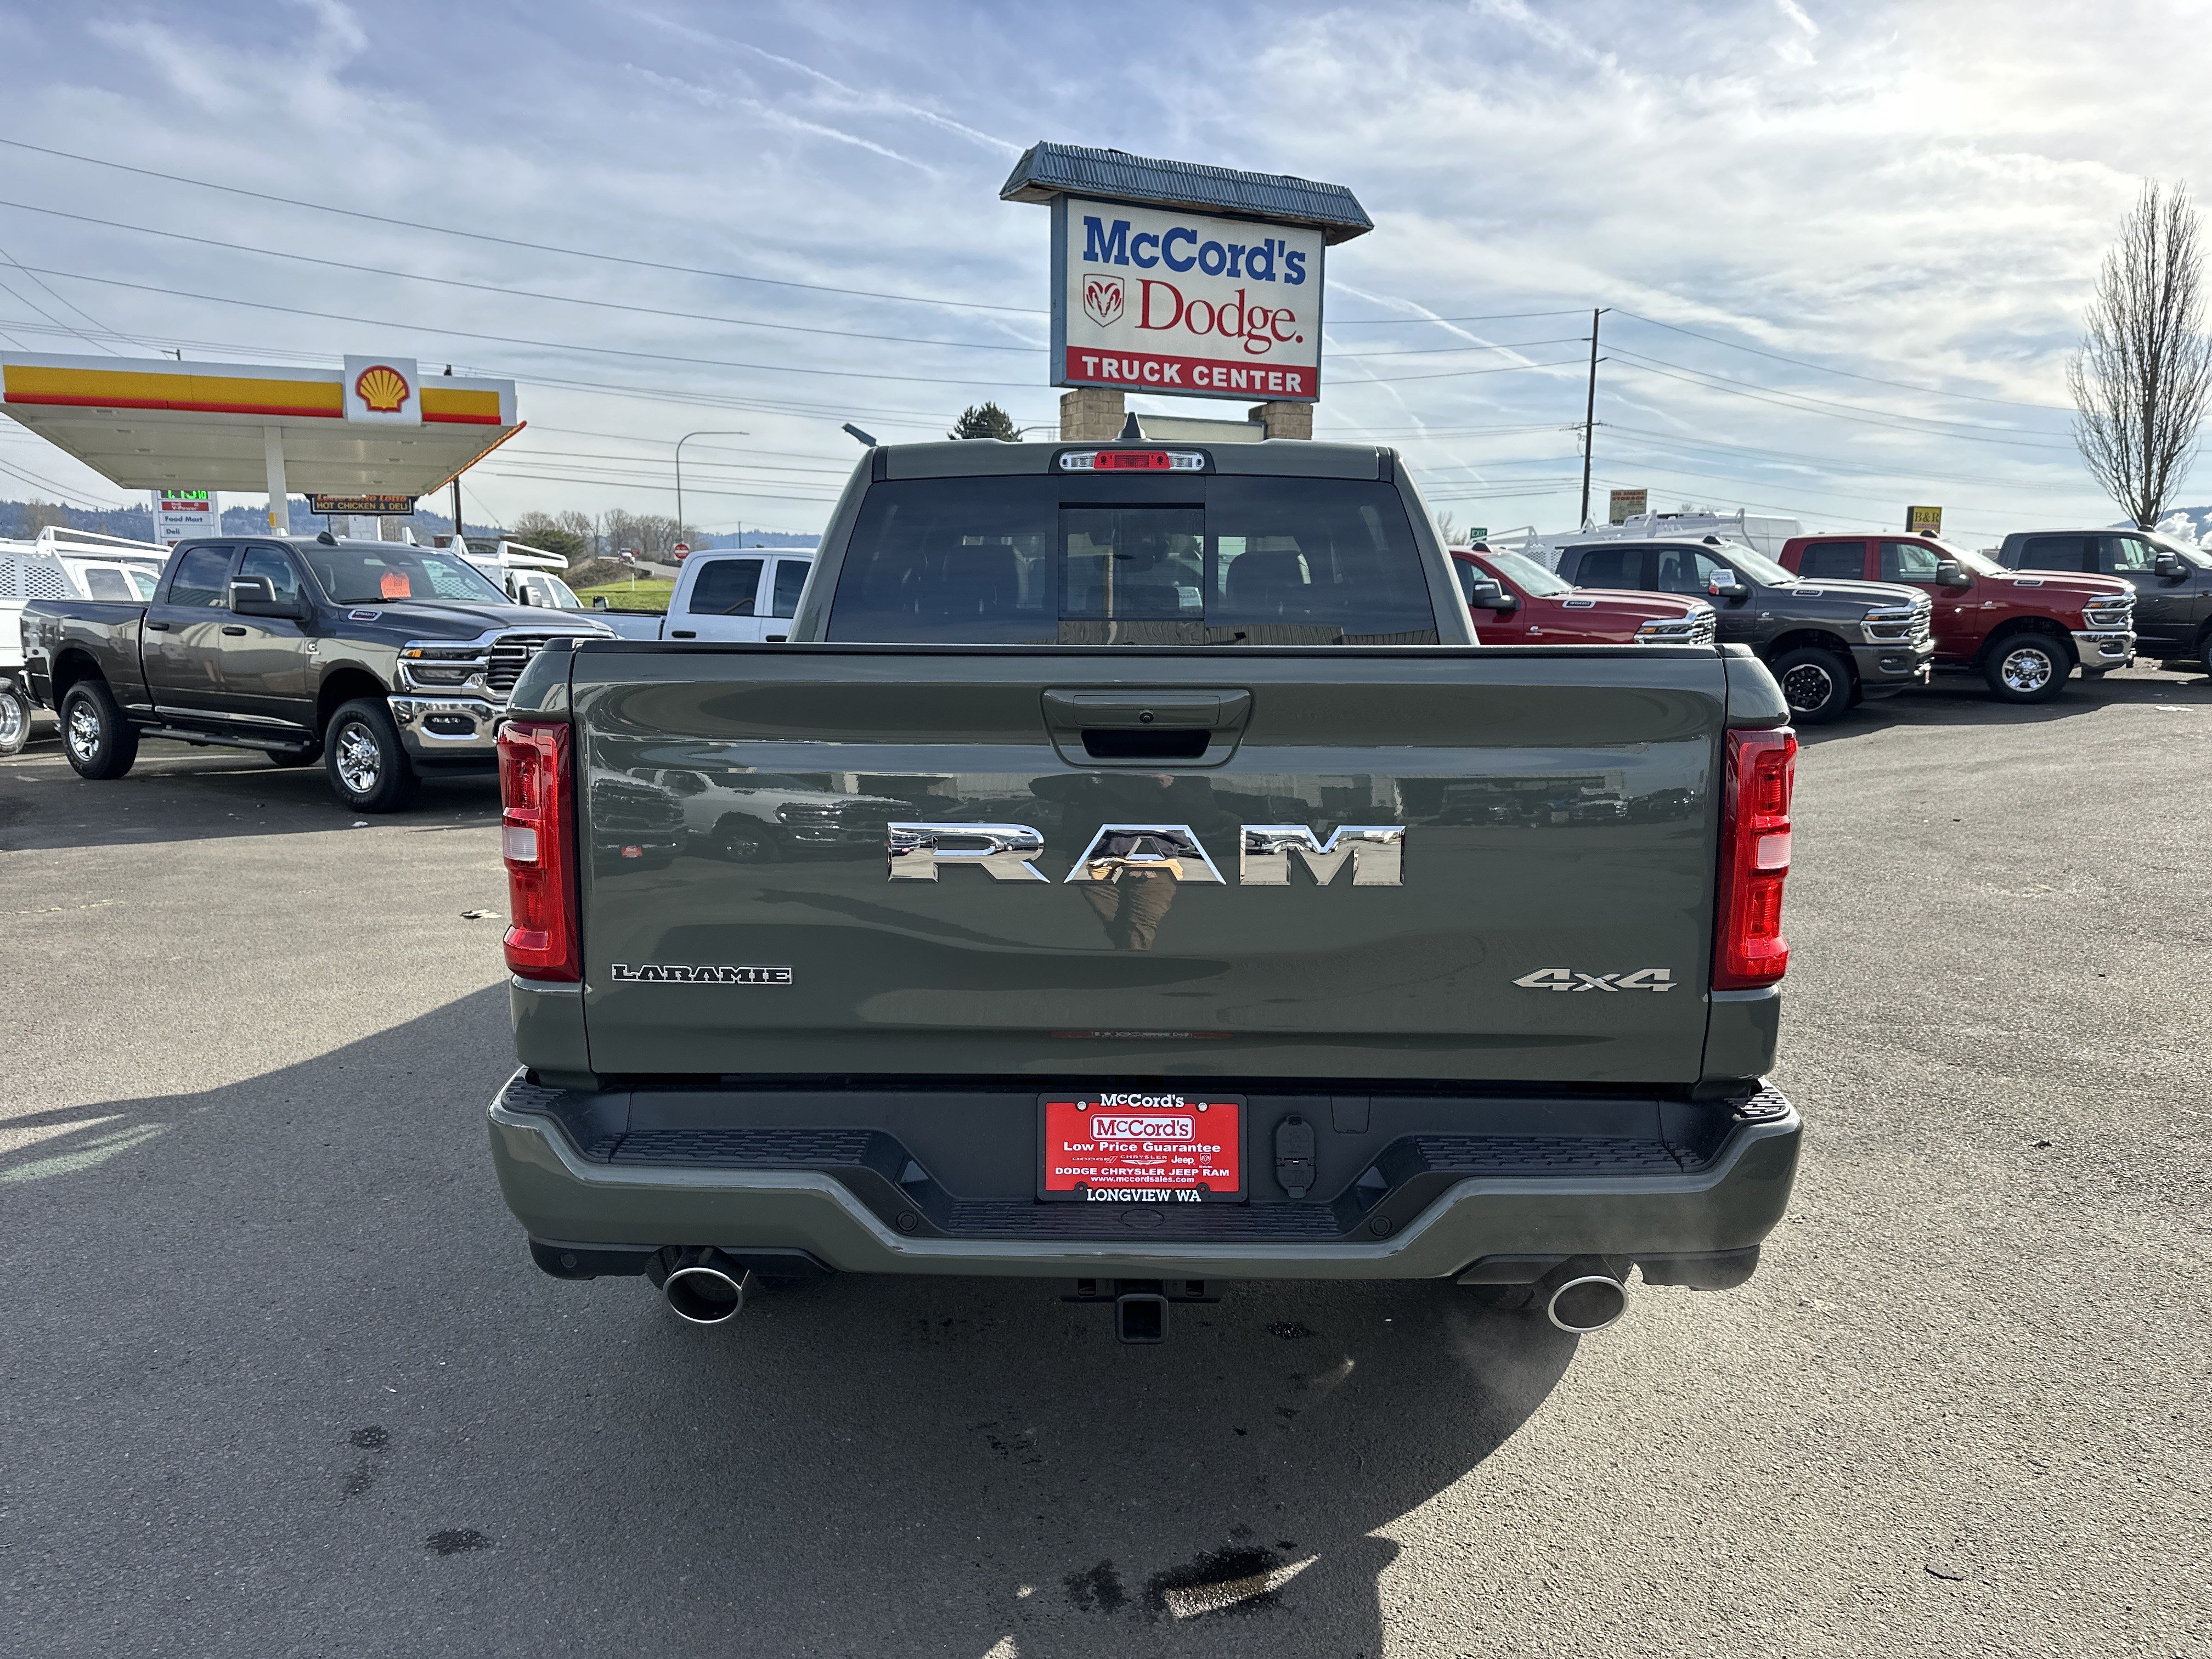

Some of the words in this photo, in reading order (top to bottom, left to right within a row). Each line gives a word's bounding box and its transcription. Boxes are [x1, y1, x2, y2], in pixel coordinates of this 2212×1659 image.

[1084, 216, 1306, 285] McCord's
[1082, 357, 1182, 384] TRUCK
[1193, 366, 1302, 393] CENTER
[1915, 512, 1939, 522] B&R
[887, 822, 1406, 886] RAM
[612, 964, 792, 984] LARAMIE
[1510, 967, 1678, 992] 4x4
[1100, 1093, 1184, 1108] McCord's
[1097, 1120, 1189, 1136] McCord's
[1064, 1141, 1095, 1152] Low
[1099, 1142, 1138, 1152] Price
[1143, 1142, 1221, 1153] Guarantee
[1091, 1175, 1195, 1183] www.mccordsales.com
[1101, 1167, 1165, 1176] CHRYSLER
[1169, 1168, 1199, 1176] JEEP
[1086, 1189, 1171, 1201] LONGVIEW
[1176, 1190, 1201, 1203] WA
